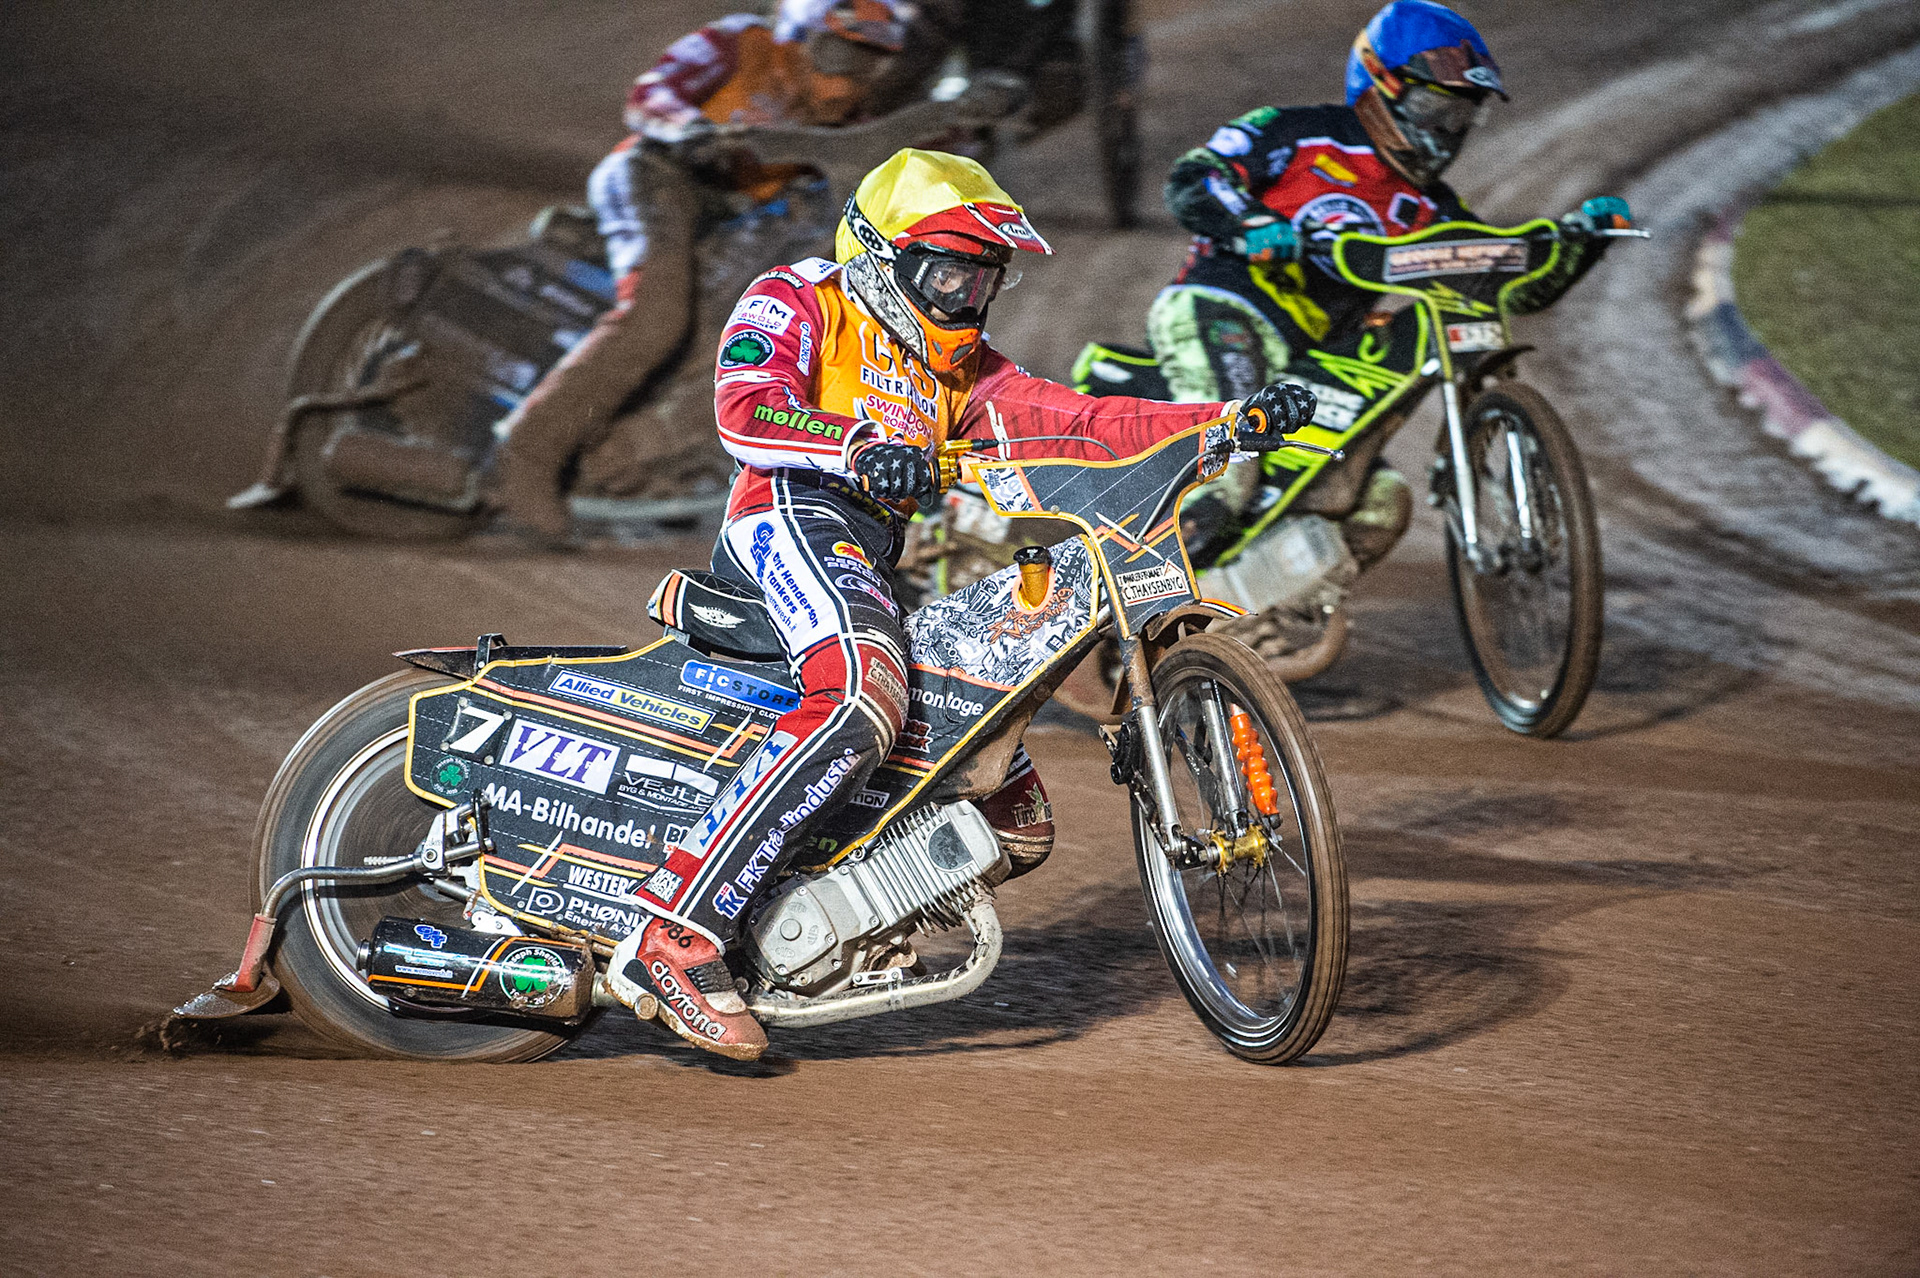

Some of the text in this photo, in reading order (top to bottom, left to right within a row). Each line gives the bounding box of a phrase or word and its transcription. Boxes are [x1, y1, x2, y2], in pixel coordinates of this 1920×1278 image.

[753, 404, 844, 440] møllen
[866, 394, 933, 439] SWINDON
[766, 570, 799, 615] Tankers
[779, 567, 820, 630] Henderson
[558, 677, 702, 726] Allied Vehicles
[677, 684, 782, 721] FIRST IMPRESSION CLOT
[450, 706, 505, 754] 7
[508, 725, 613, 784] VLT
[568, 865, 638, 896] WESTER
[651, 960, 728, 1042] daytona
